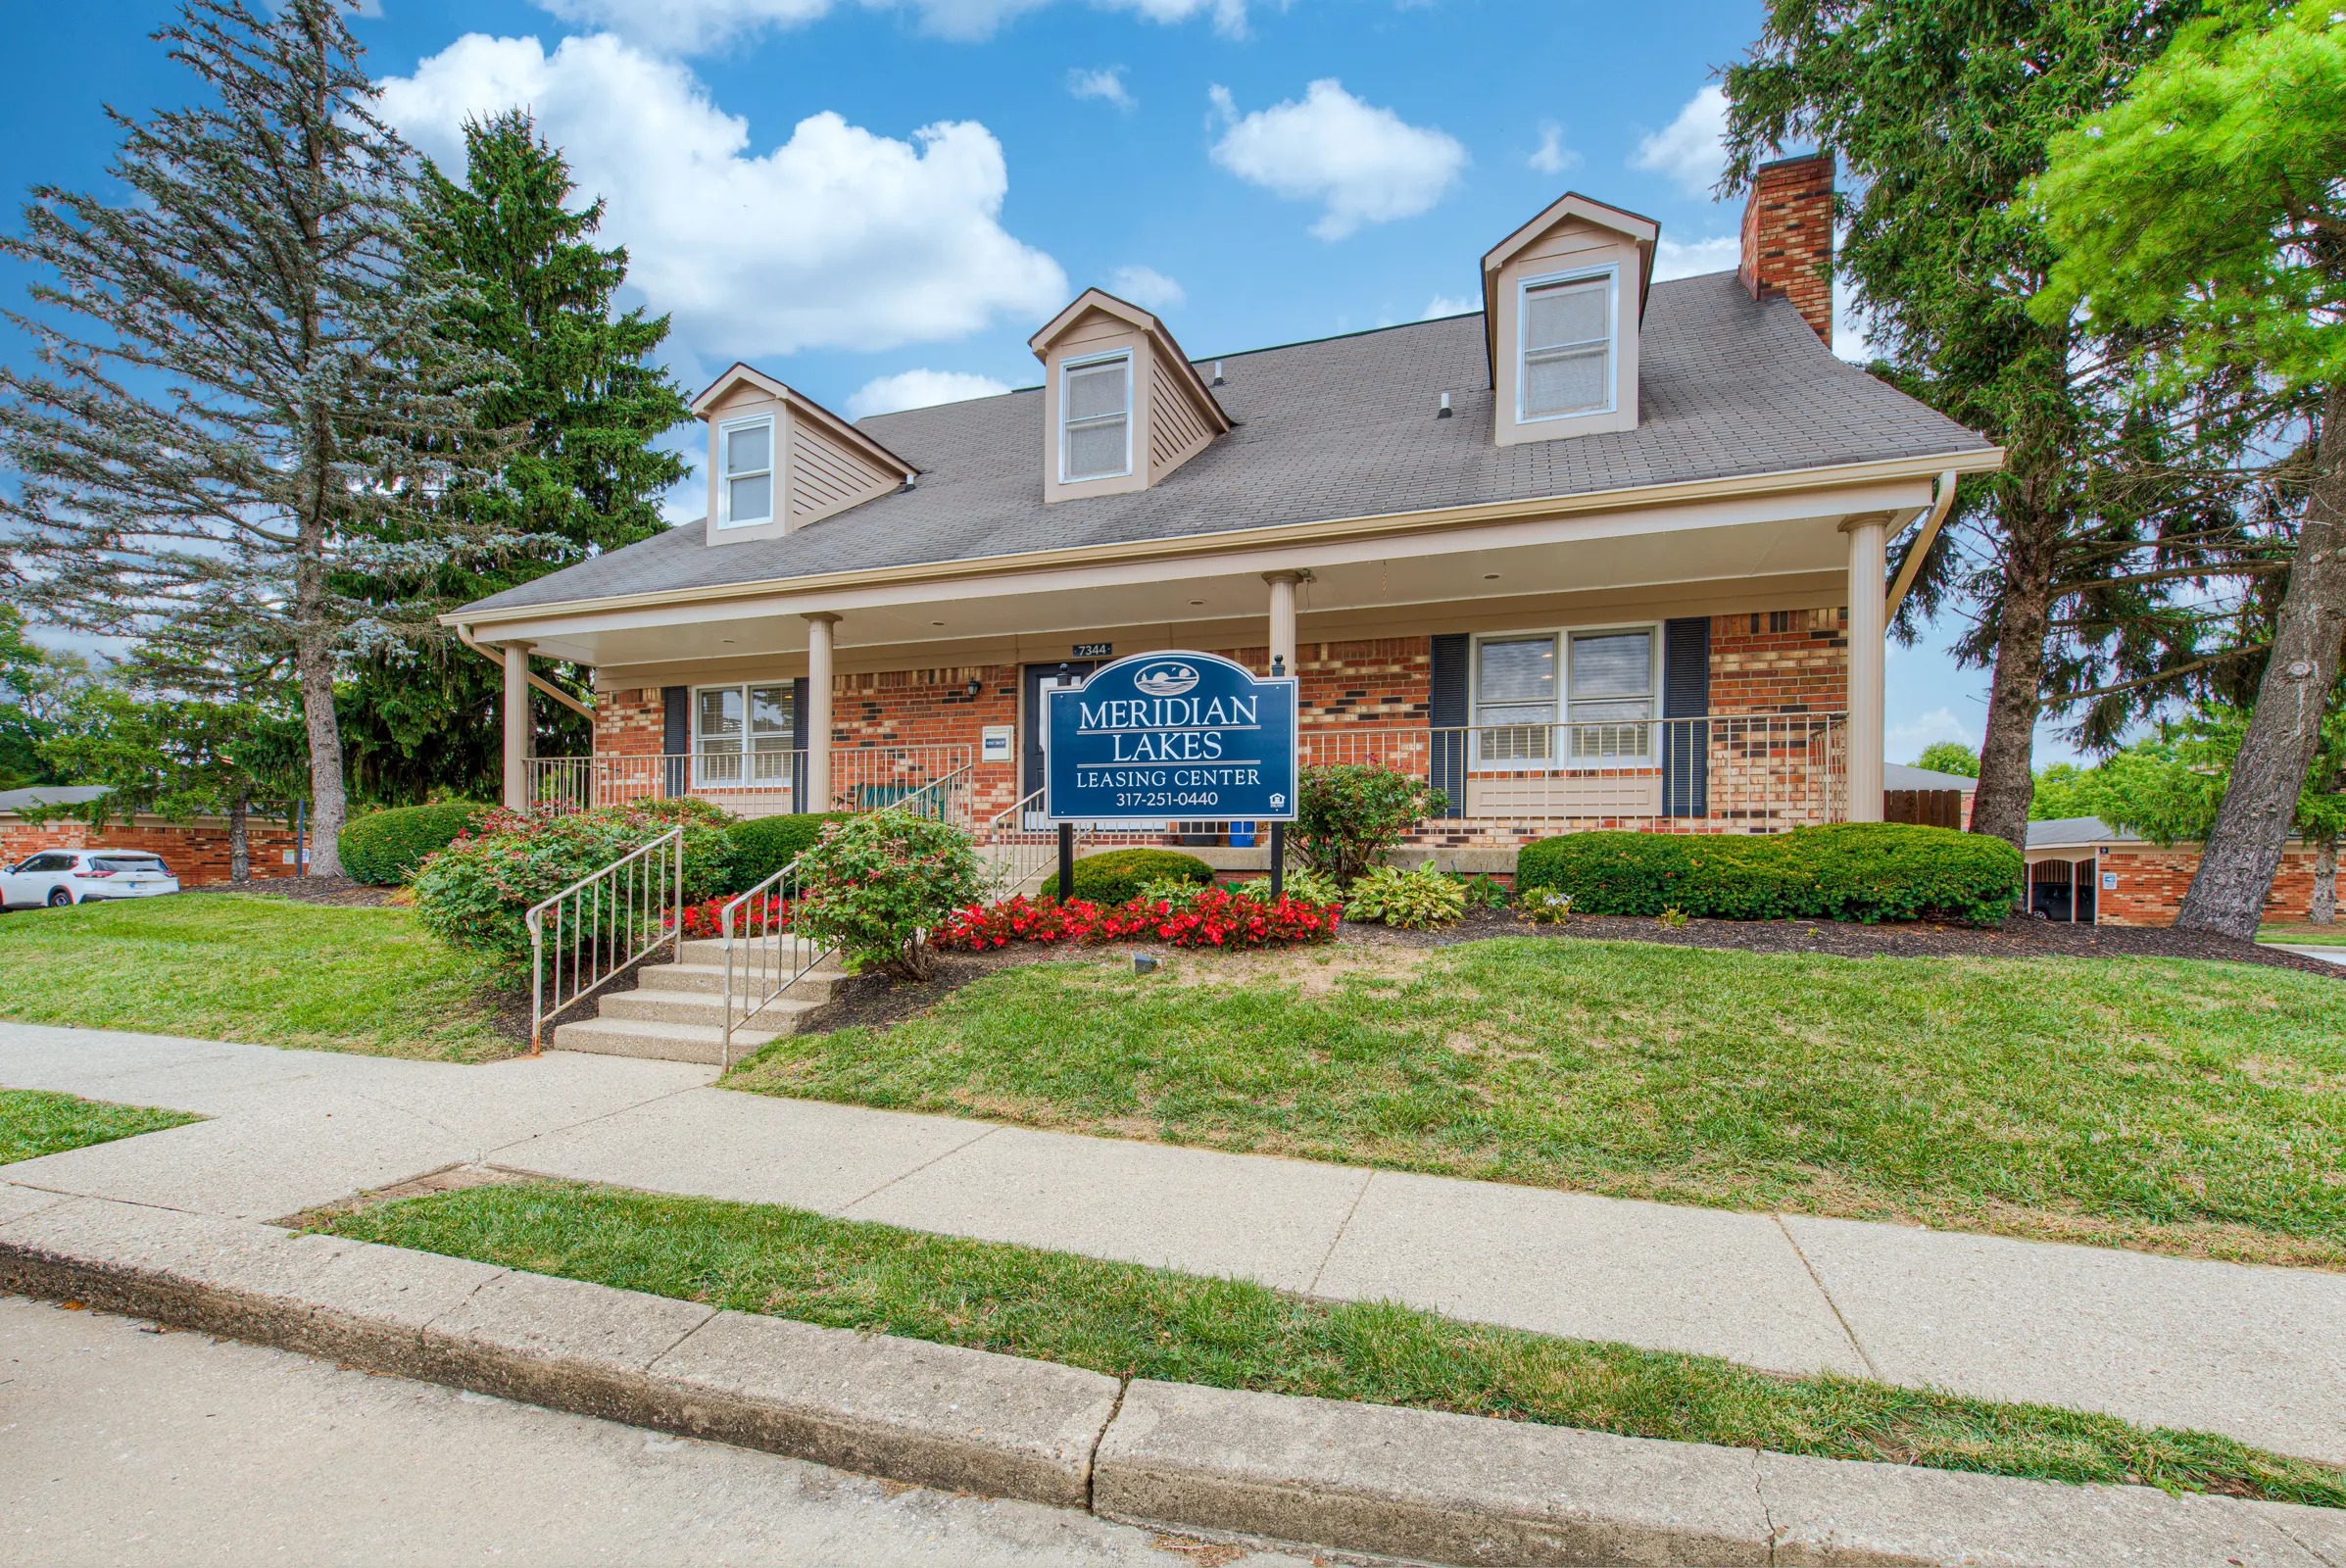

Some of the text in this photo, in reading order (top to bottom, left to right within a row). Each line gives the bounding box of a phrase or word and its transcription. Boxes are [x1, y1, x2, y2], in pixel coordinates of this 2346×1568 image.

[1078, 644, 1106, 656] 7344
[1079, 695, 1258, 729] MERIDIAN
[1113, 731, 1222, 761] LAKES
[1076, 769, 1260, 788] LEASING CENTER
[1116, 791, 1218, 807] 317-251-0440
